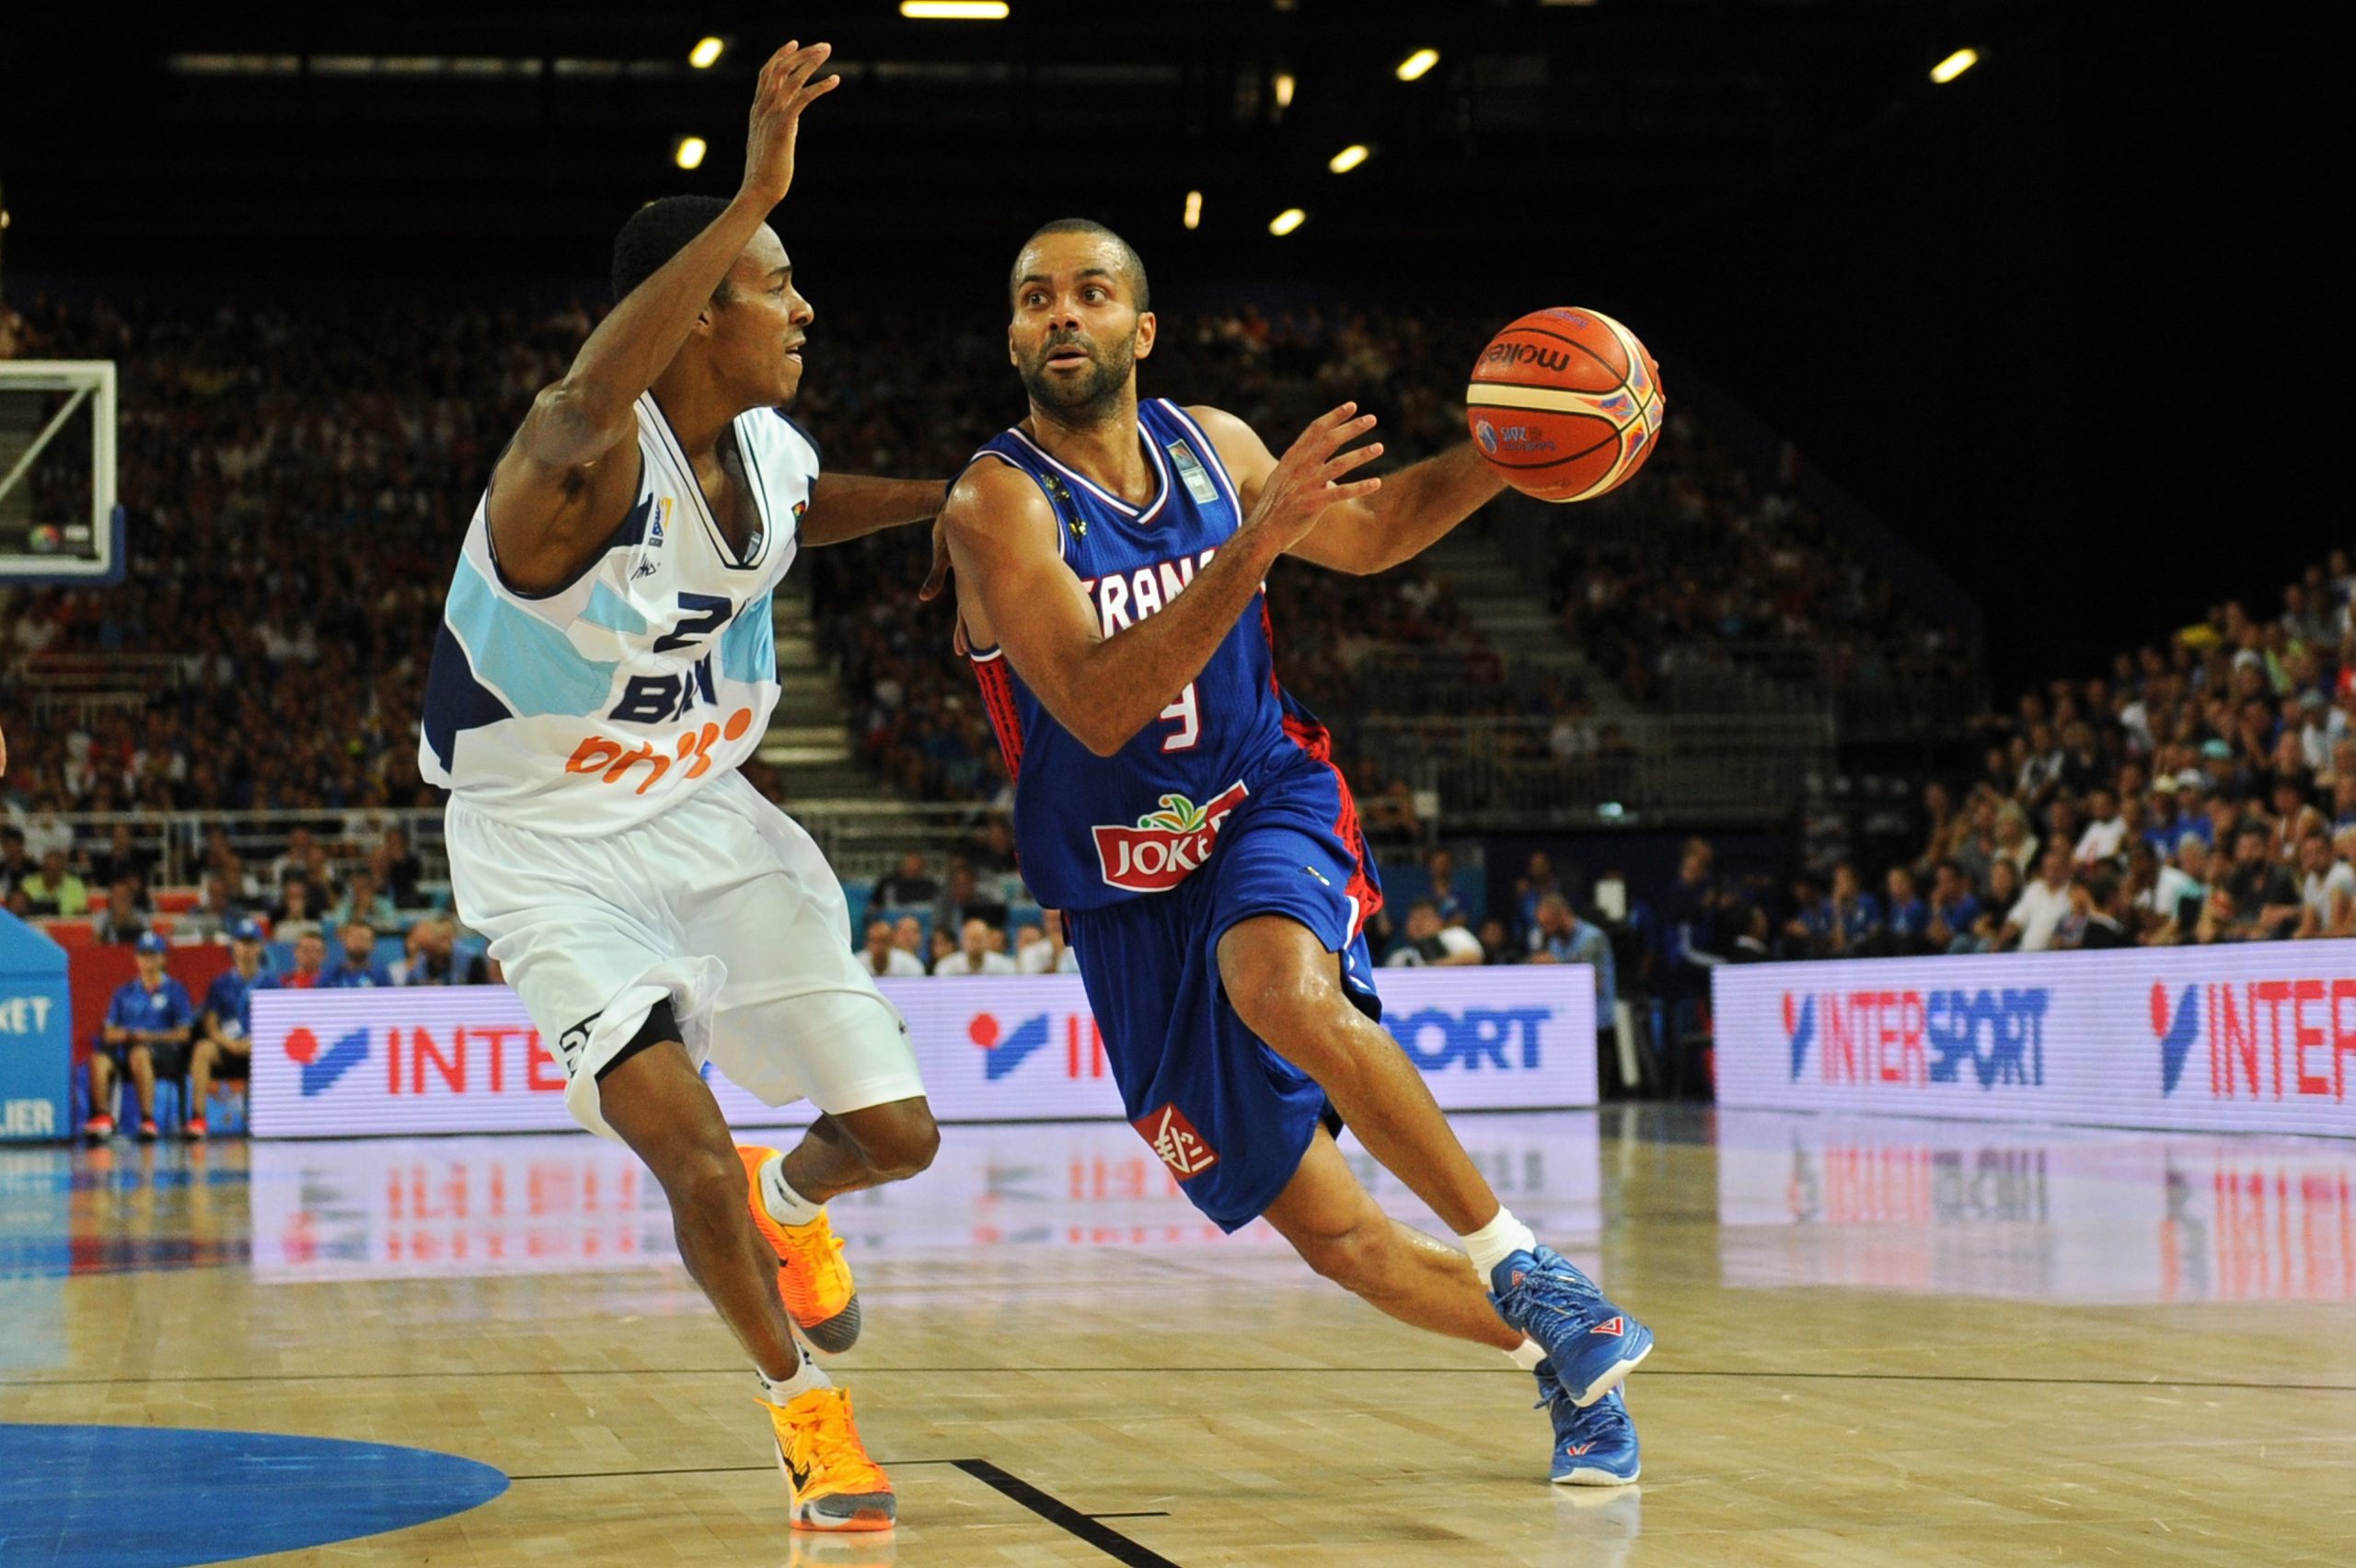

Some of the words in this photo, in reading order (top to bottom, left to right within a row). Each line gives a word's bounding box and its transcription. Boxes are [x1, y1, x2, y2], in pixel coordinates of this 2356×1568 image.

[653, 591, 733, 654] 2
[1081, 548, 1219, 640] RAN
[387, 1025, 568, 1094] INTE
[1381, 1007, 1553, 1071] ORT
[1820, 987, 2049, 1091] INTERSPORT
